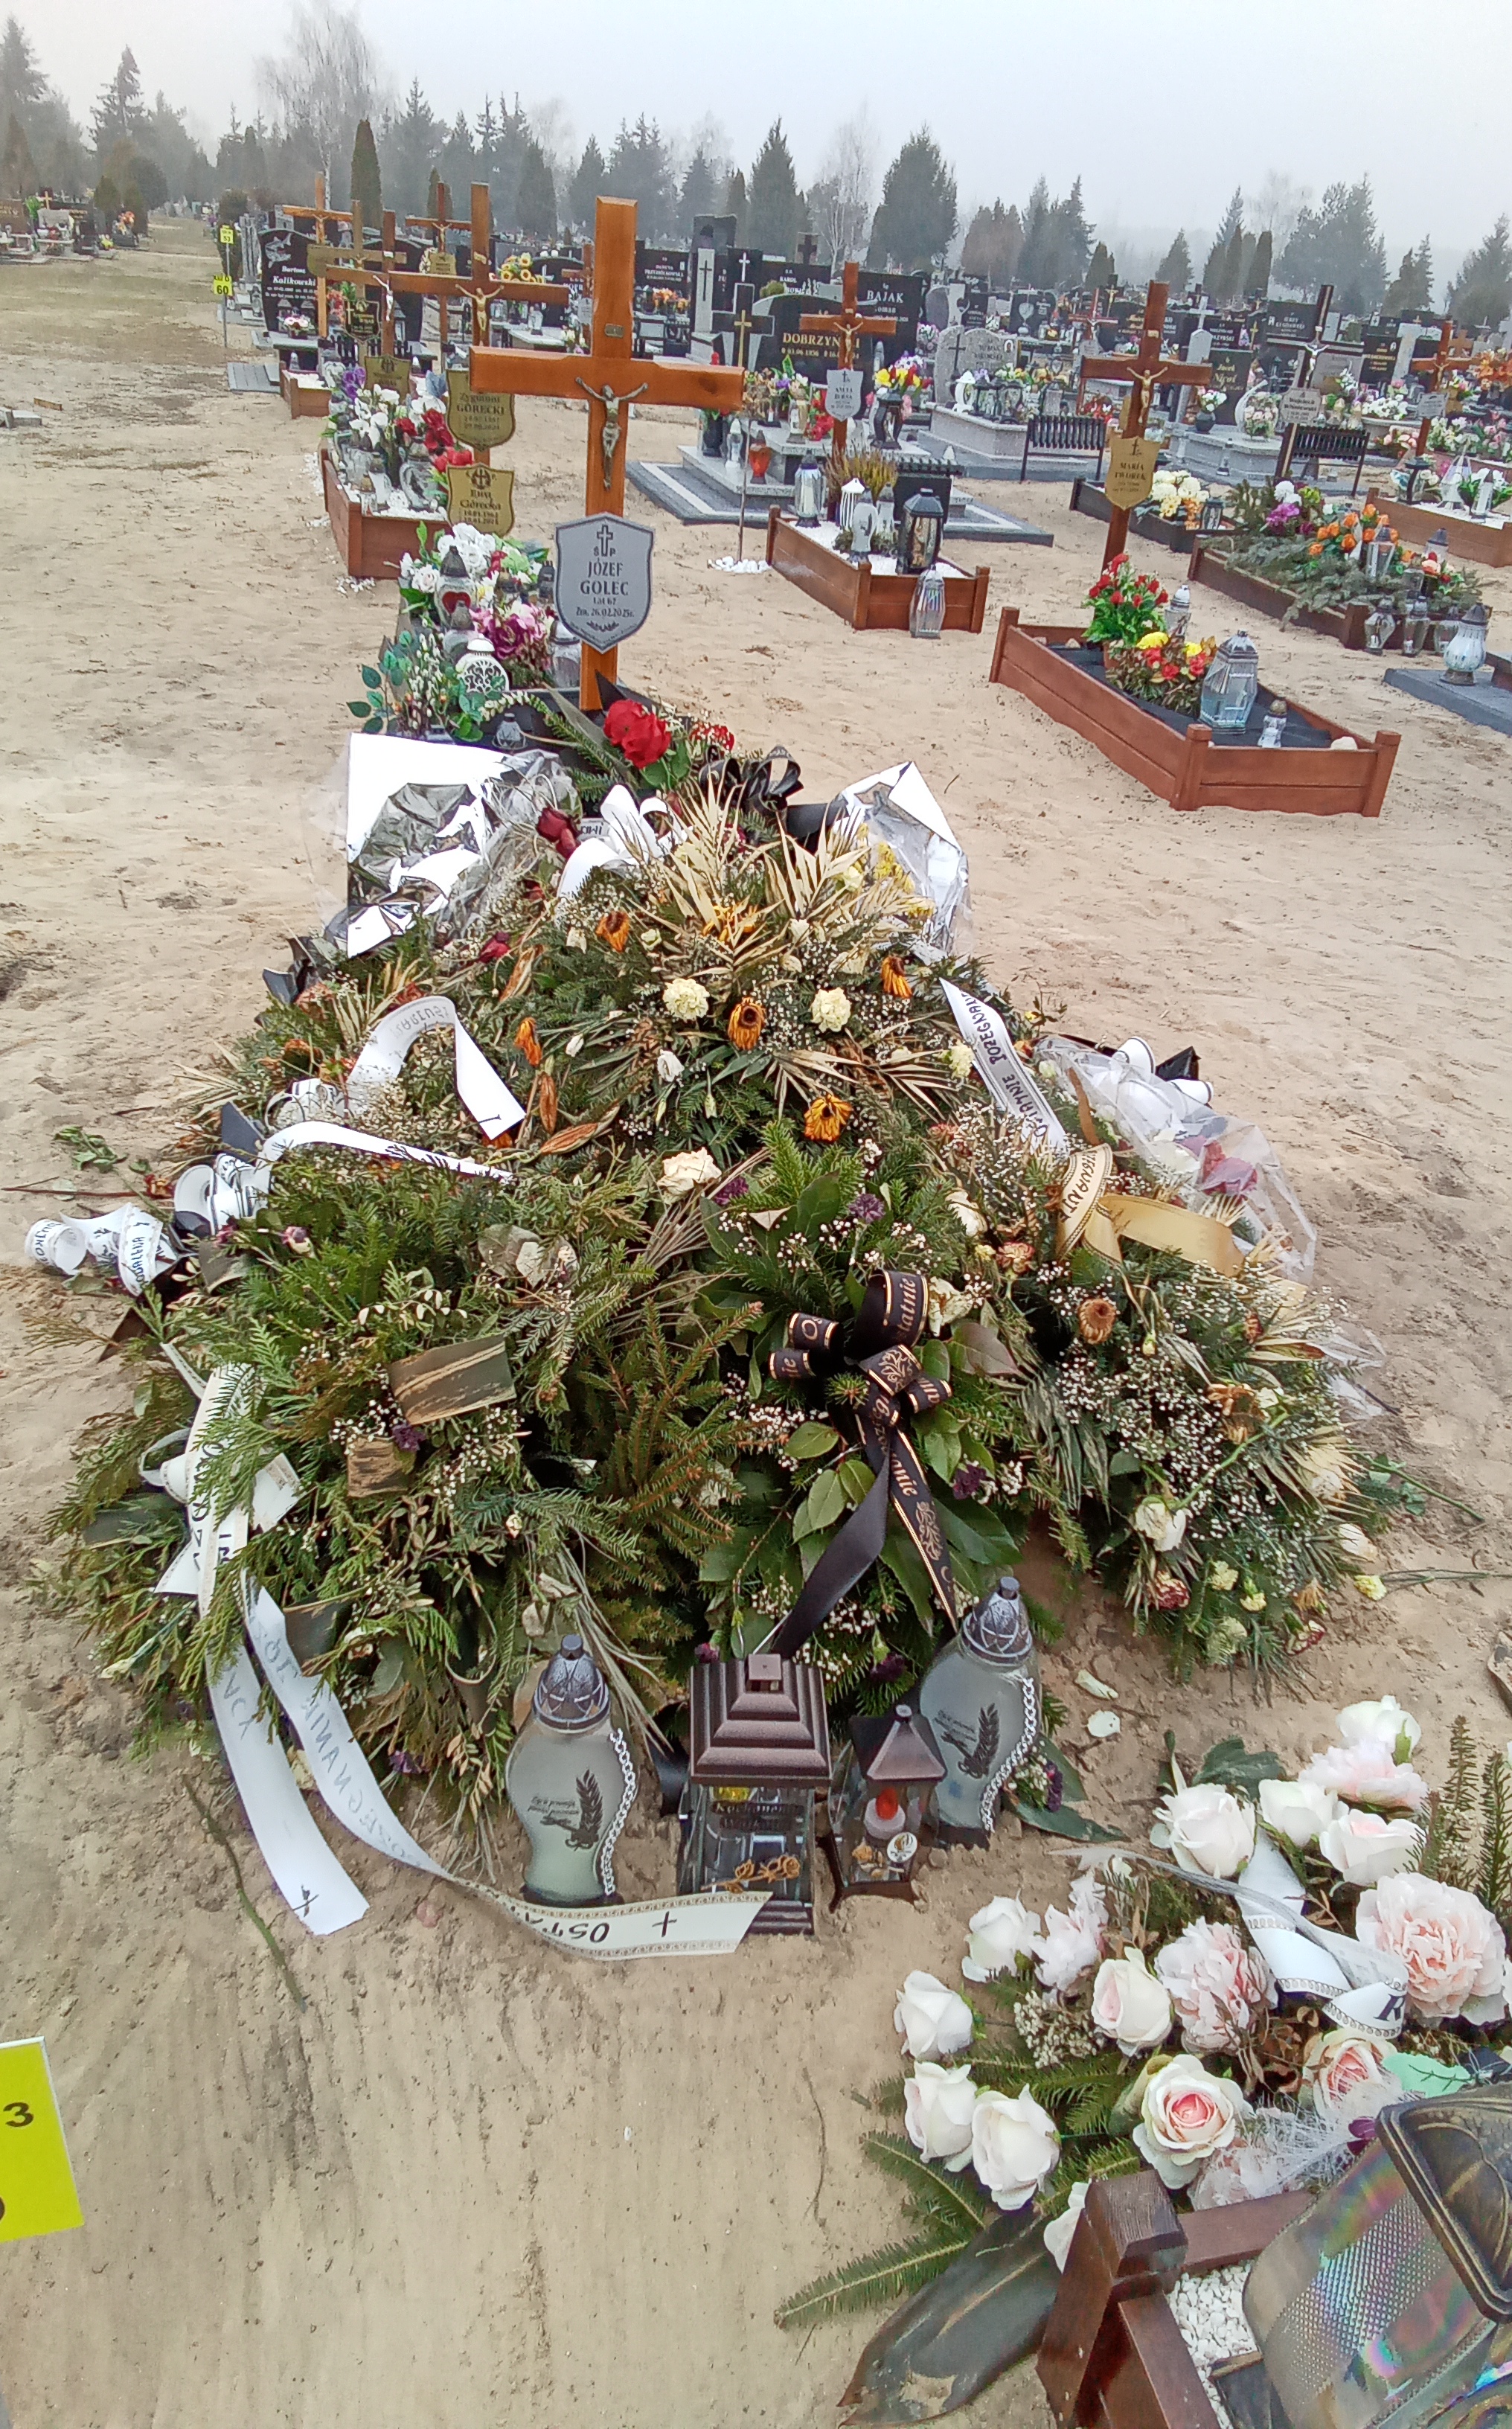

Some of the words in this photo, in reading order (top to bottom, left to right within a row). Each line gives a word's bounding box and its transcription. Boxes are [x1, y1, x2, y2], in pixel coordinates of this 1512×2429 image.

[217, 285, 229, 295] 60
[867, 290, 904, 303] BAJAK
[457, 403, 504, 415] GÓRECKI
[588, 557, 624, 578] JÓZEF
[580, 580, 629, 595] GOLEC
[3, 2101, 35, 2128] 3
